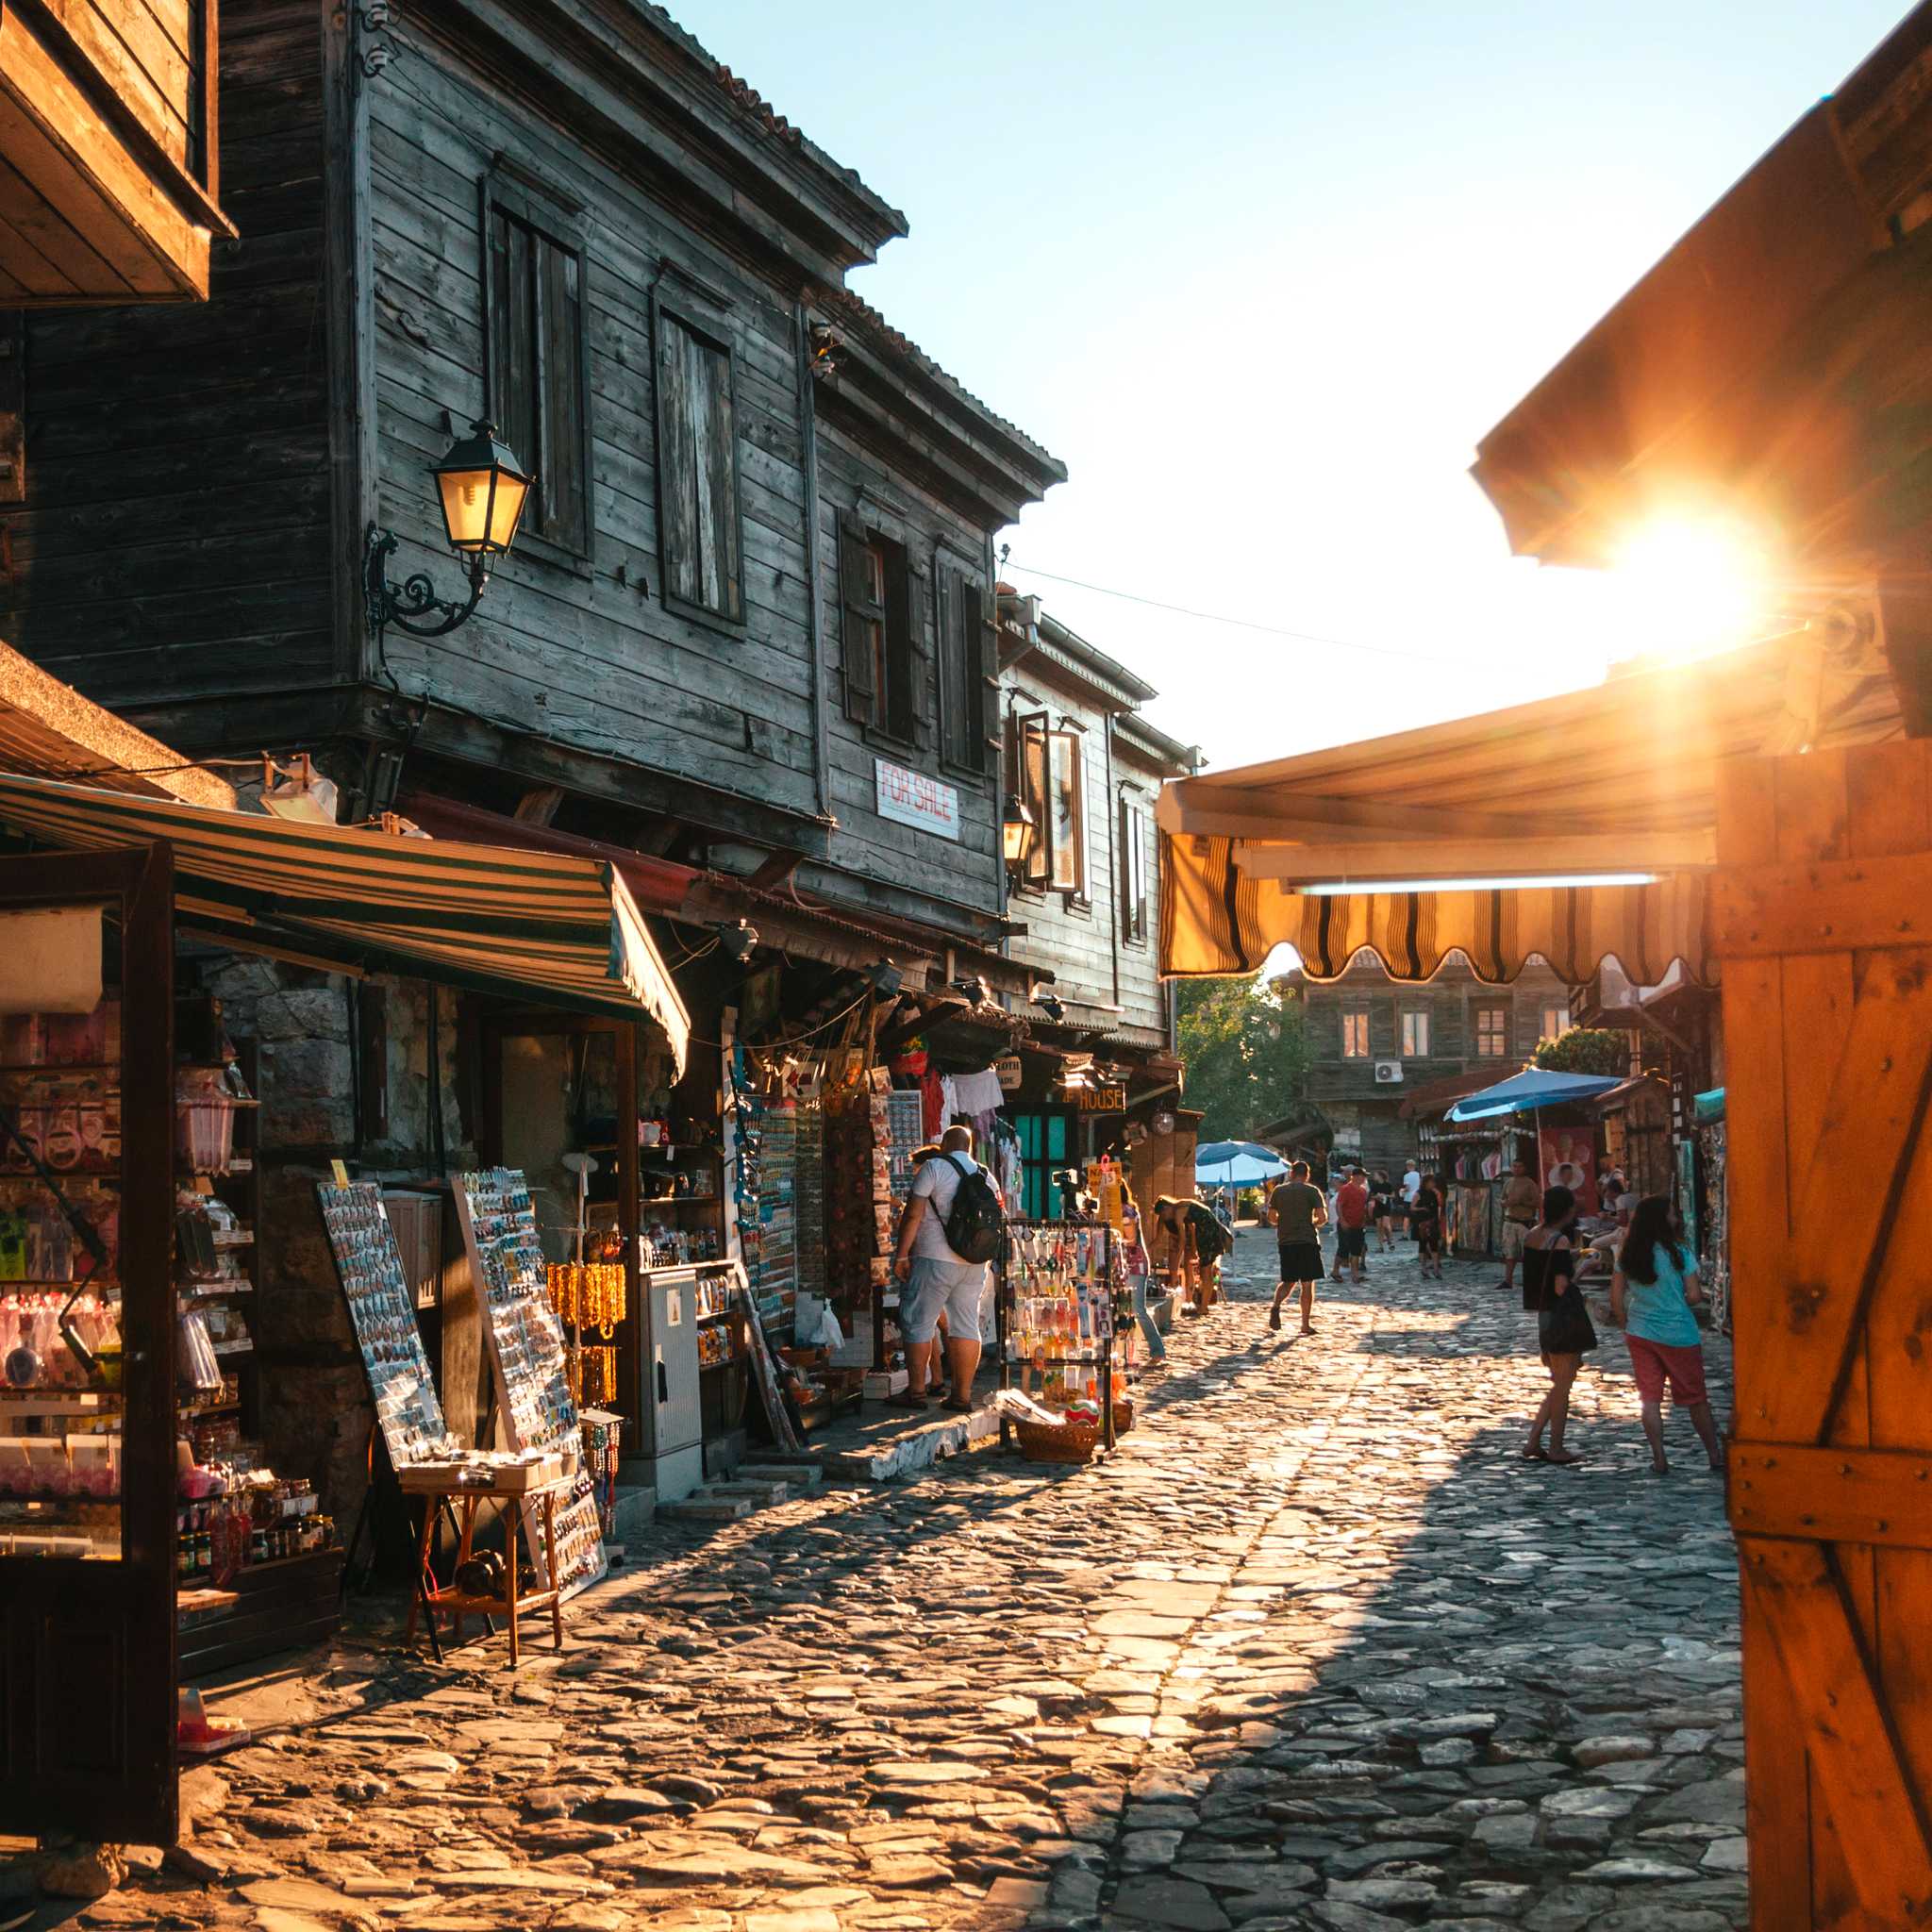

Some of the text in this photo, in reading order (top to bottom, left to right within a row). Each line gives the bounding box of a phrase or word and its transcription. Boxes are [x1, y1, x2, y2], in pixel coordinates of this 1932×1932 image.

[882, 763, 952, 823] FOR SALE
[1079, 1088, 1124, 1110] HOUSE
